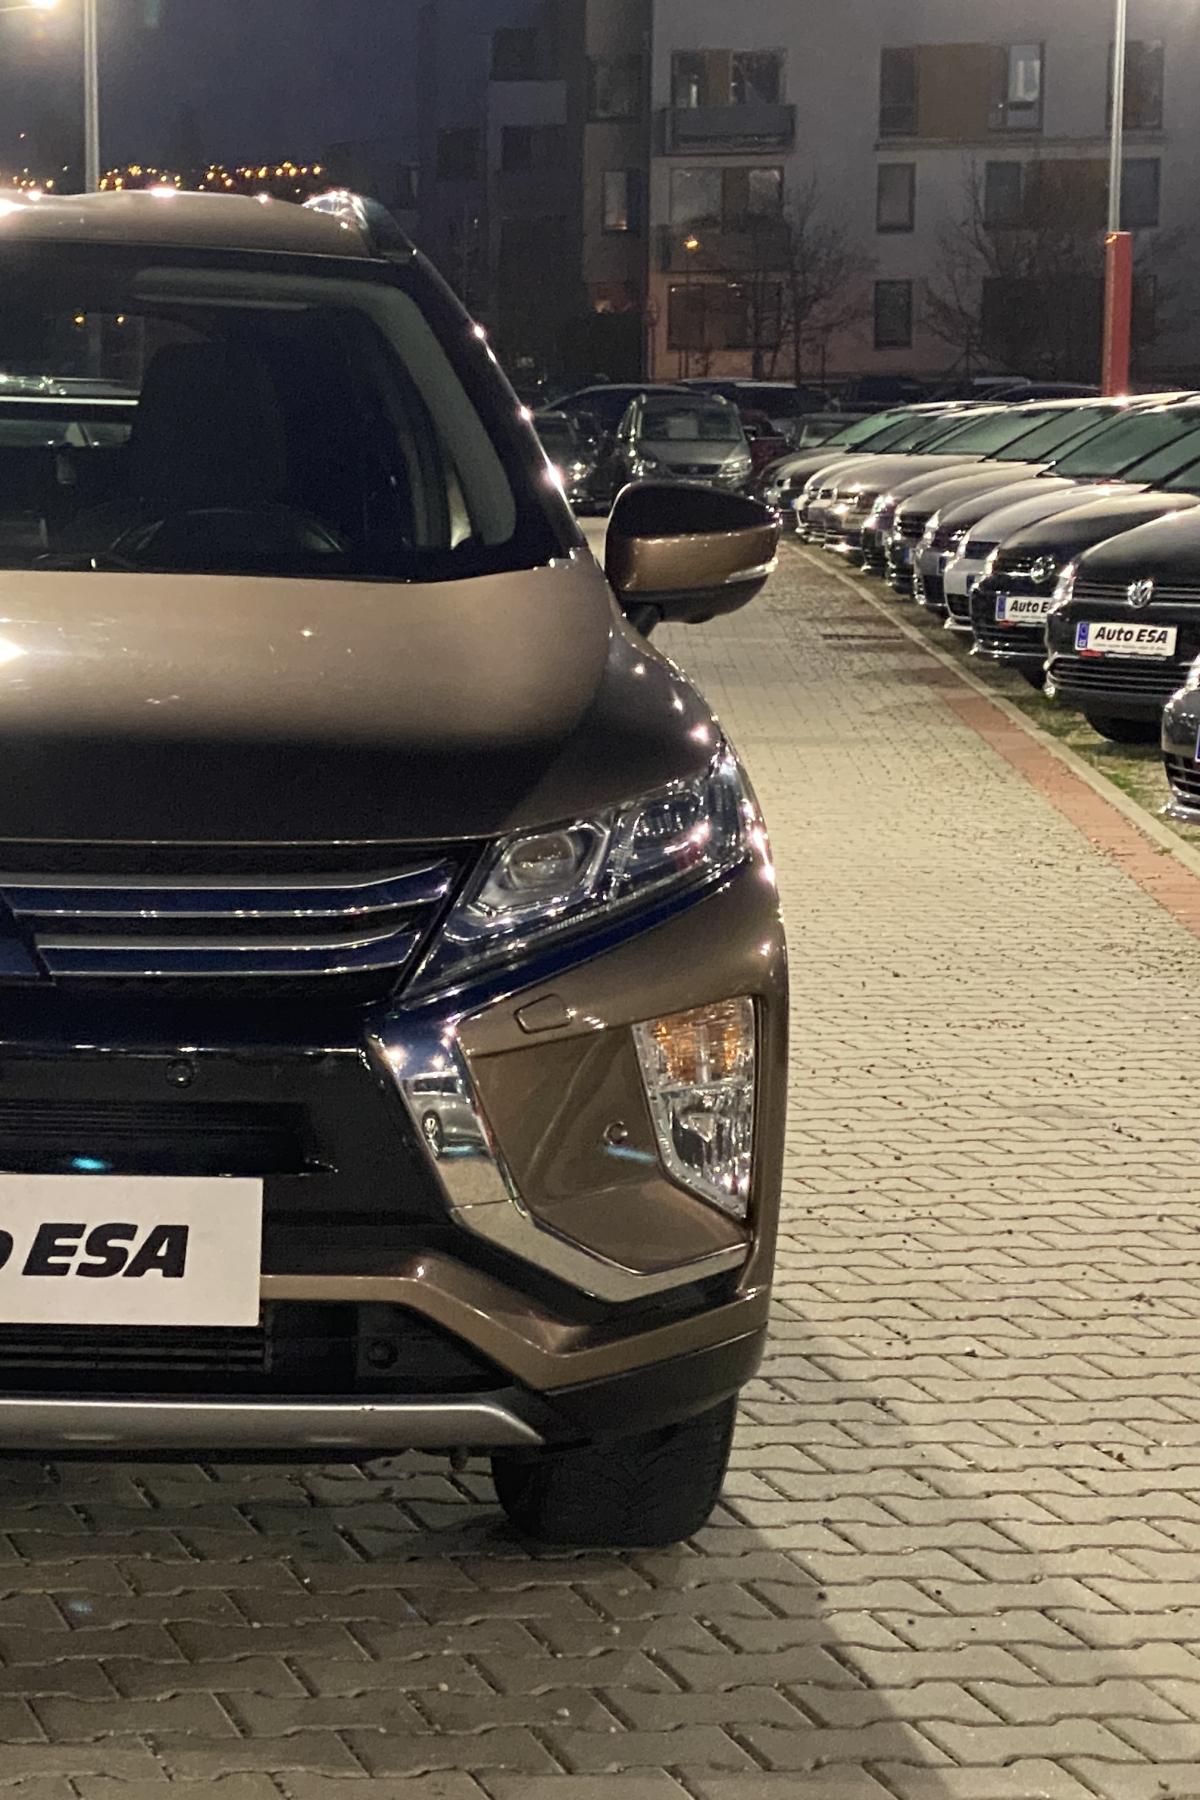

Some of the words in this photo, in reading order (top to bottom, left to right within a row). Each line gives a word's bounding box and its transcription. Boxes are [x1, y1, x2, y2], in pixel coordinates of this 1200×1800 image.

[1009, 600, 1039, 612] Auto
[1094, 626, 1134, 641] Auto
[1135, 629, 1169, 644] ESA
[21, 1222, 190, 1278] ESA
